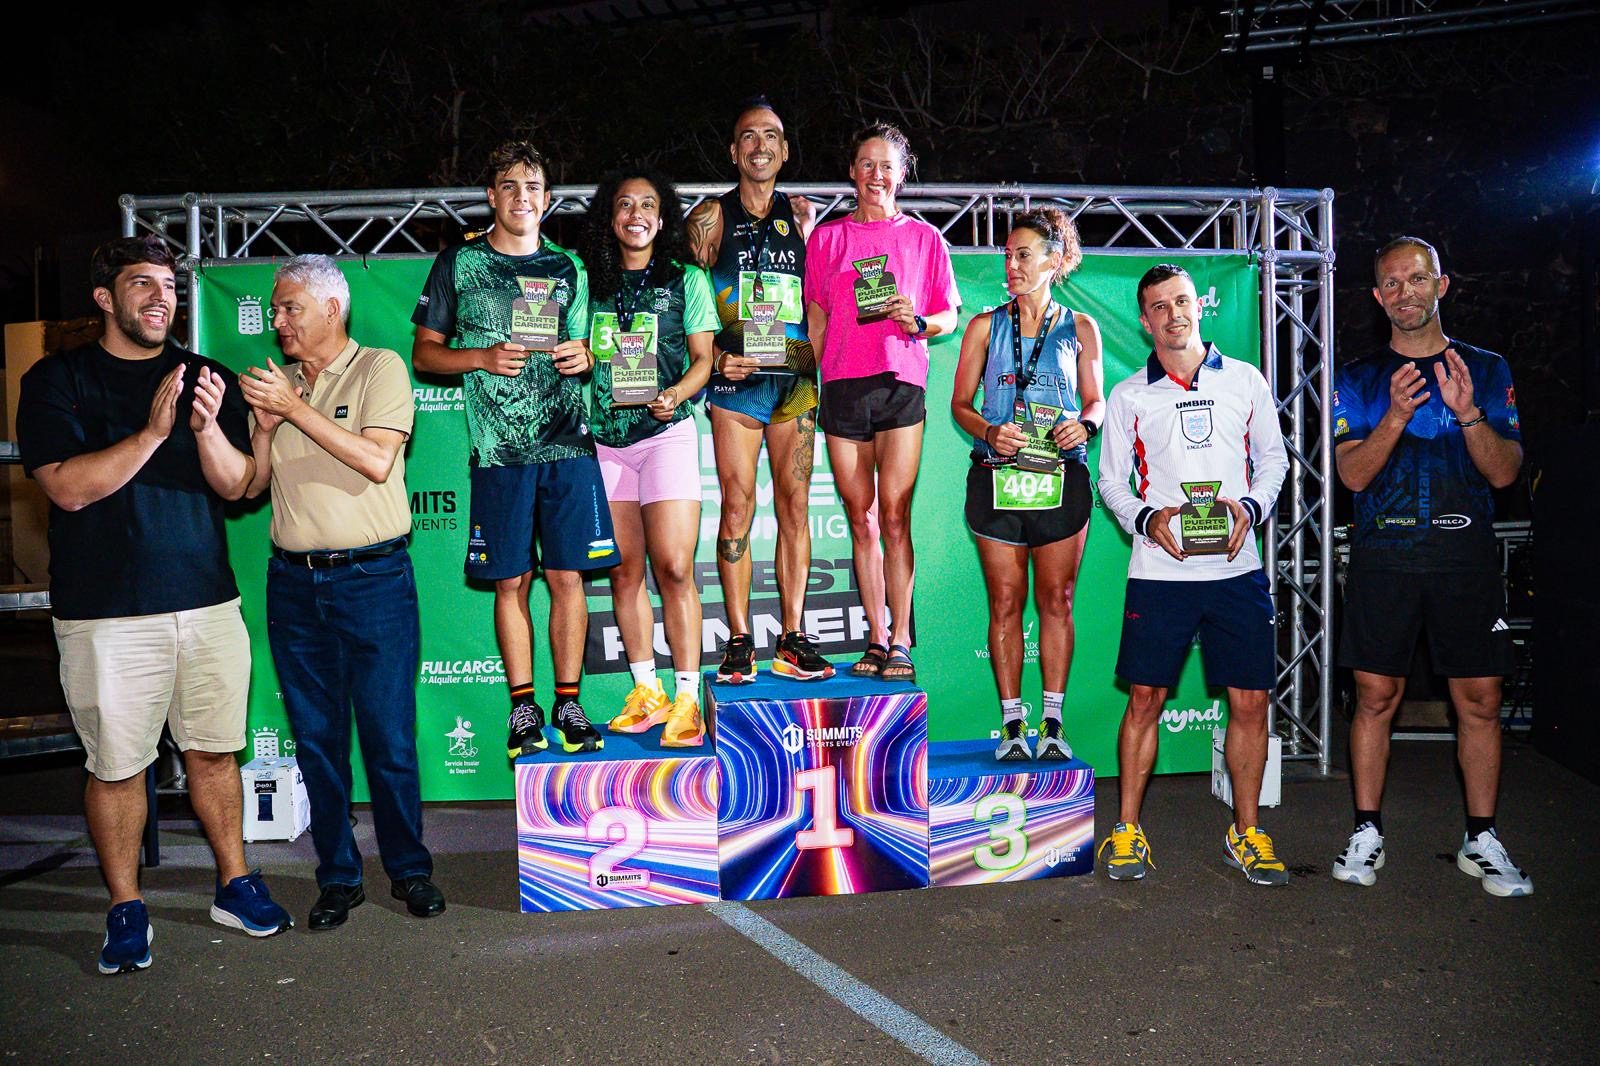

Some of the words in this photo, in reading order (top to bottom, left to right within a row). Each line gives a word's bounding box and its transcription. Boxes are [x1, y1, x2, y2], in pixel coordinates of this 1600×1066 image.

[525, 281, 548, 289] MUSIC
[858, 286, 895, 297] PUERTO
[858, 291, 896, 302] CARMEN
[514, 315, 557, 323] PUERTO
[514, 321, 556, 329] CARMEN
[614, 375, 655, 383] CARMEN
[997, 373, 1067, 390] SPOSCLUB
[412, 387, 466, 402] FULLCA
[454, 402, 465, 411] de
[1175, 399, 1215, 409] UMBRO
[1035, 412, 1055, 420] RUN
[1003, 474, 1055, 498] 404
[411, 490, 456, 514] MITS
[412, 518, 457, 530] VENTS
[428, 675, 461, 685] Alquiler
[463, 674, 474, 683] de
[476, 674, 508, 685] Furgon
[1158, 700, 1223, 732] mynd
[806, 726, 863, 741] SUMMITS
[836, 739, 864, 747] EVENTS
[794, 766, 854, 851] 1
[973, 792, 1029, 870] 3
[586, 805, 651, 891] 2
